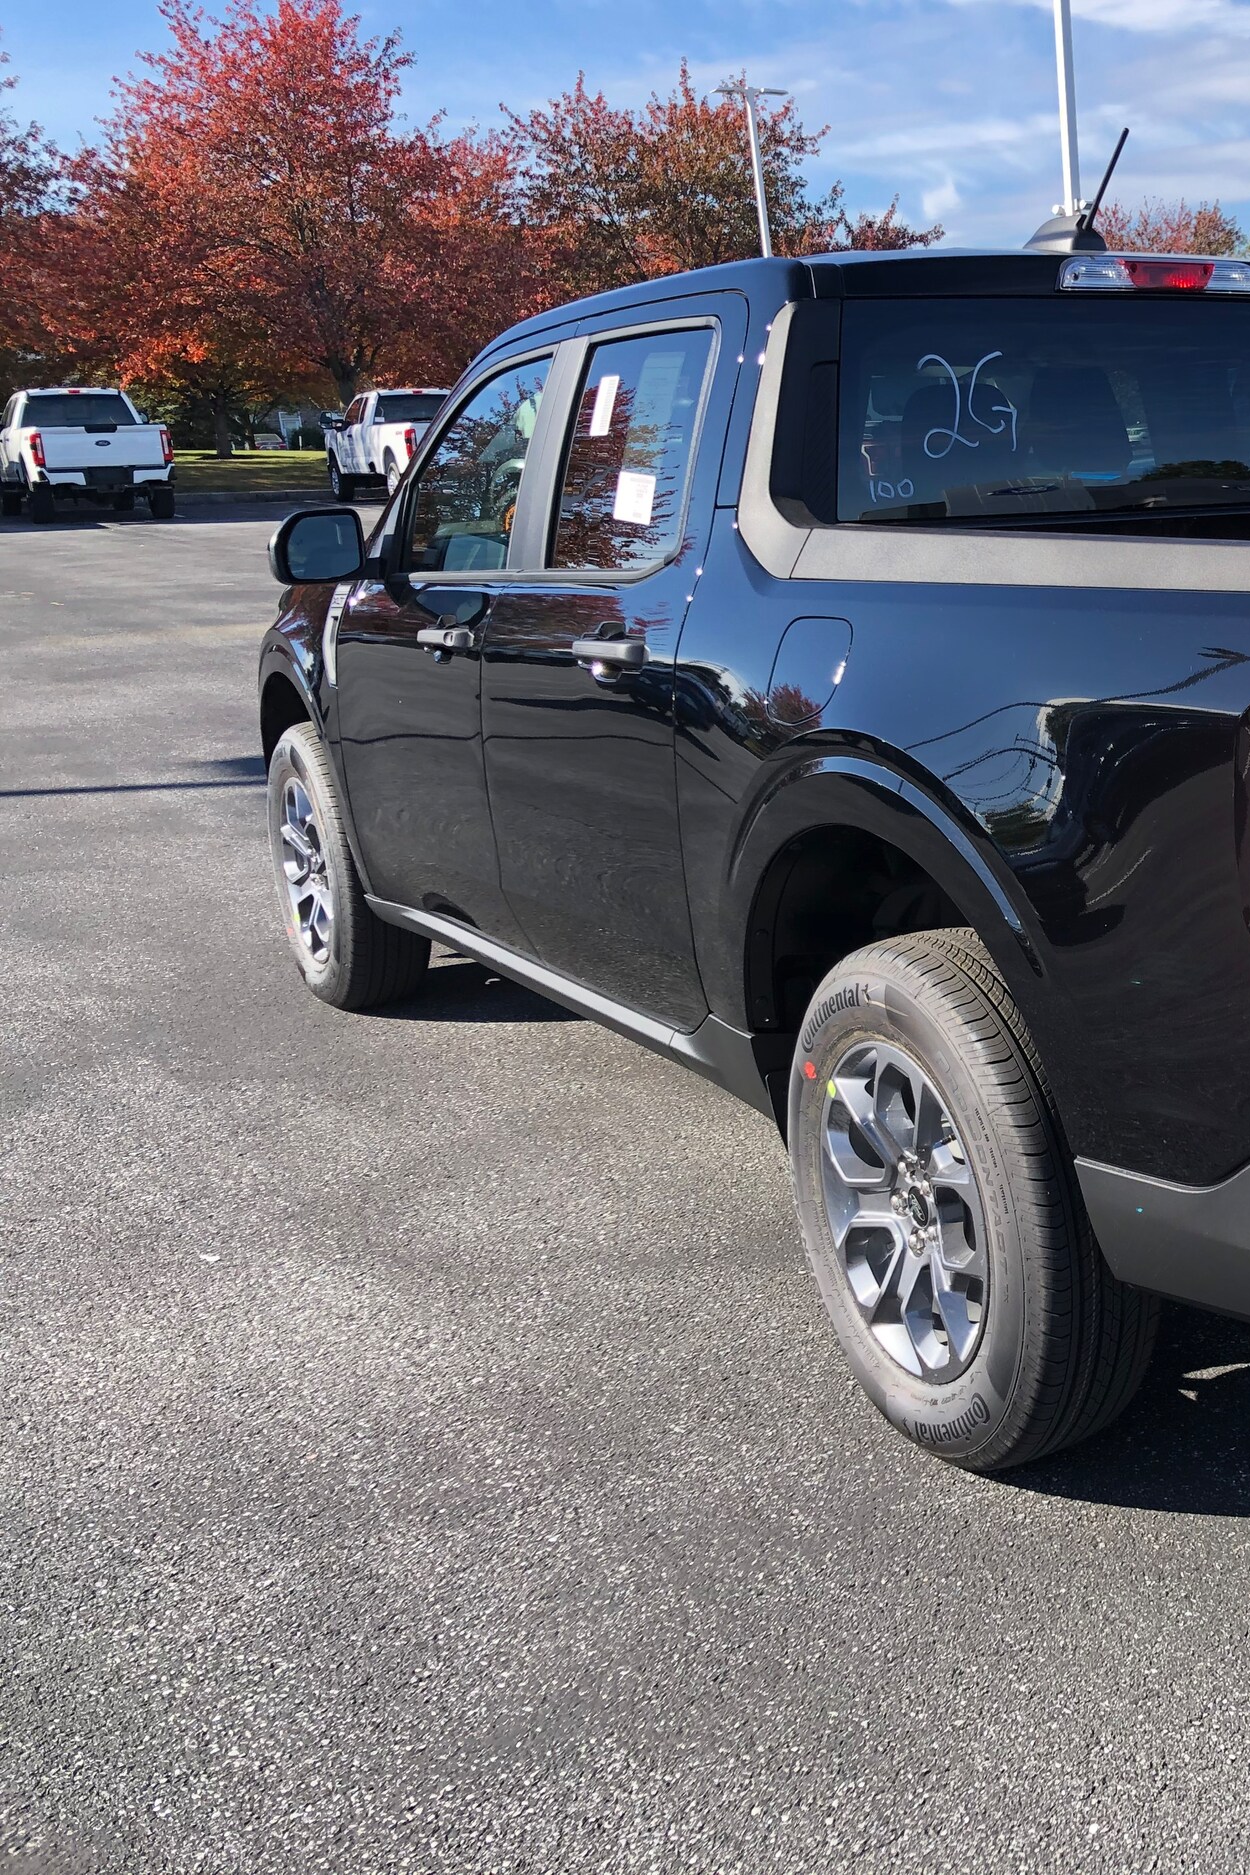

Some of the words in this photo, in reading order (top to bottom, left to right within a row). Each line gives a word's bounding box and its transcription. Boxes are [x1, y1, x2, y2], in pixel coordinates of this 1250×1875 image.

[870, 478, 914, 502] 100
[801, 982, 861, 1053] Continental
[914, 1392, 991, 1446] Continental
